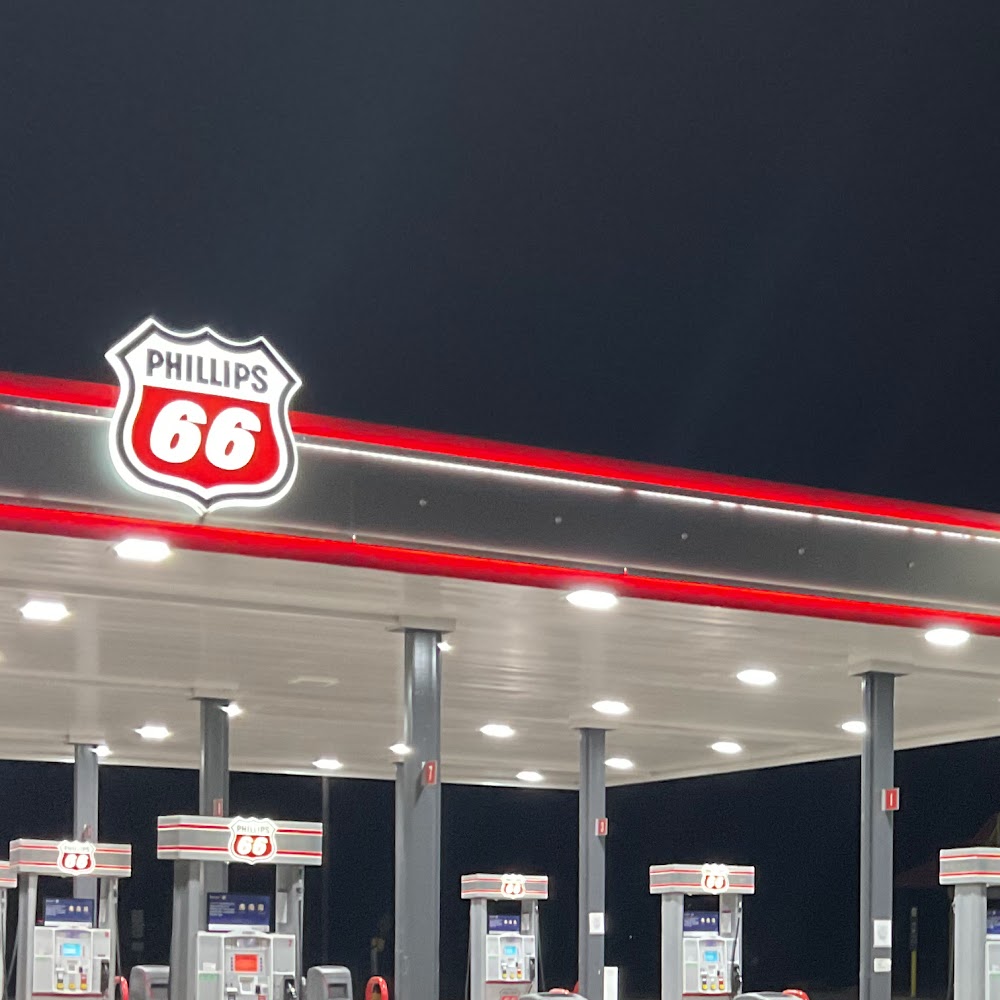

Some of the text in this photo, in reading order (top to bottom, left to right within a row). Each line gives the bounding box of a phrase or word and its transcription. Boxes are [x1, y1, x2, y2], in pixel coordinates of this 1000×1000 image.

[146, 348, 269, 394] PHILLIPS
[149, 399, 262, 471] 66
[236, 825, 270, 834] PHILLIPS
[236, 835, 269, 856] 66
